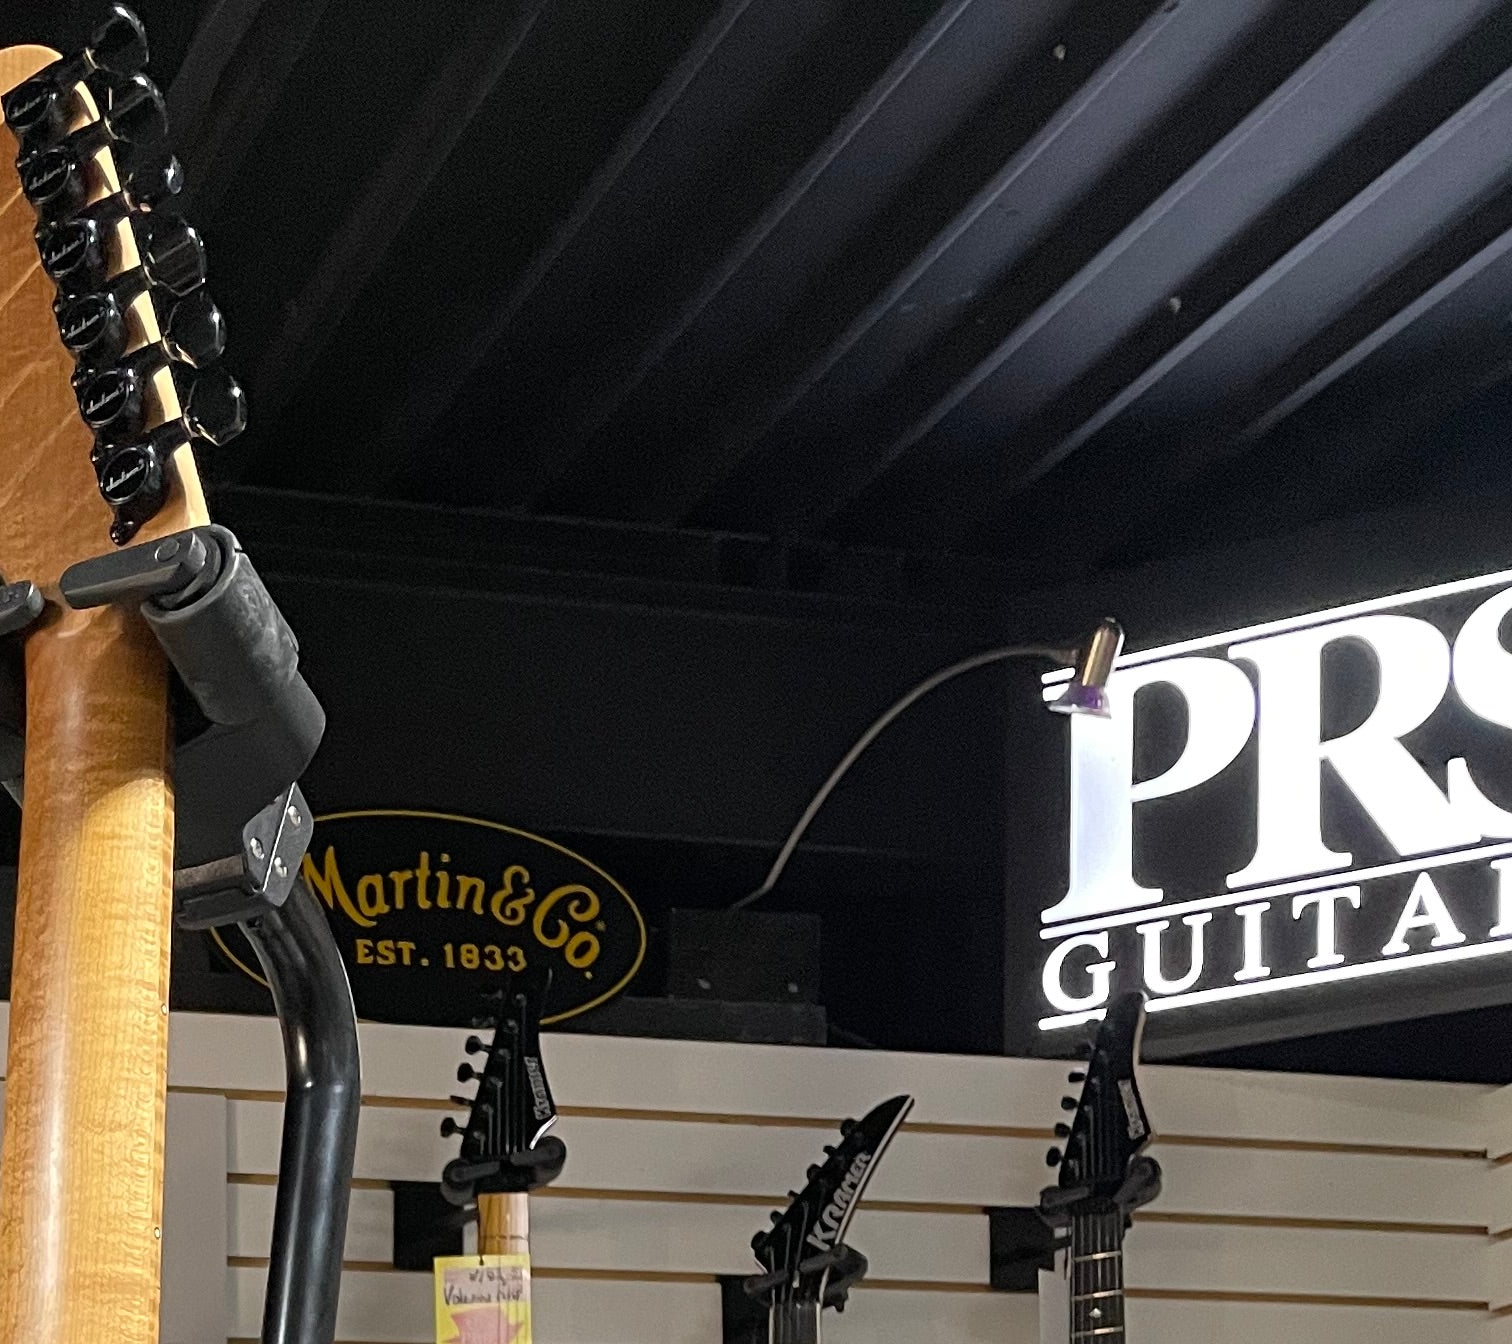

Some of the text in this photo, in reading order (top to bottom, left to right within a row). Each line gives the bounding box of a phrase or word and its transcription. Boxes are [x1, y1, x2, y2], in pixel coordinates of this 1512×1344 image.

[356, 939, 527, 973] EST. 1833
[806, 1151, 872, 1251] KRAMER
